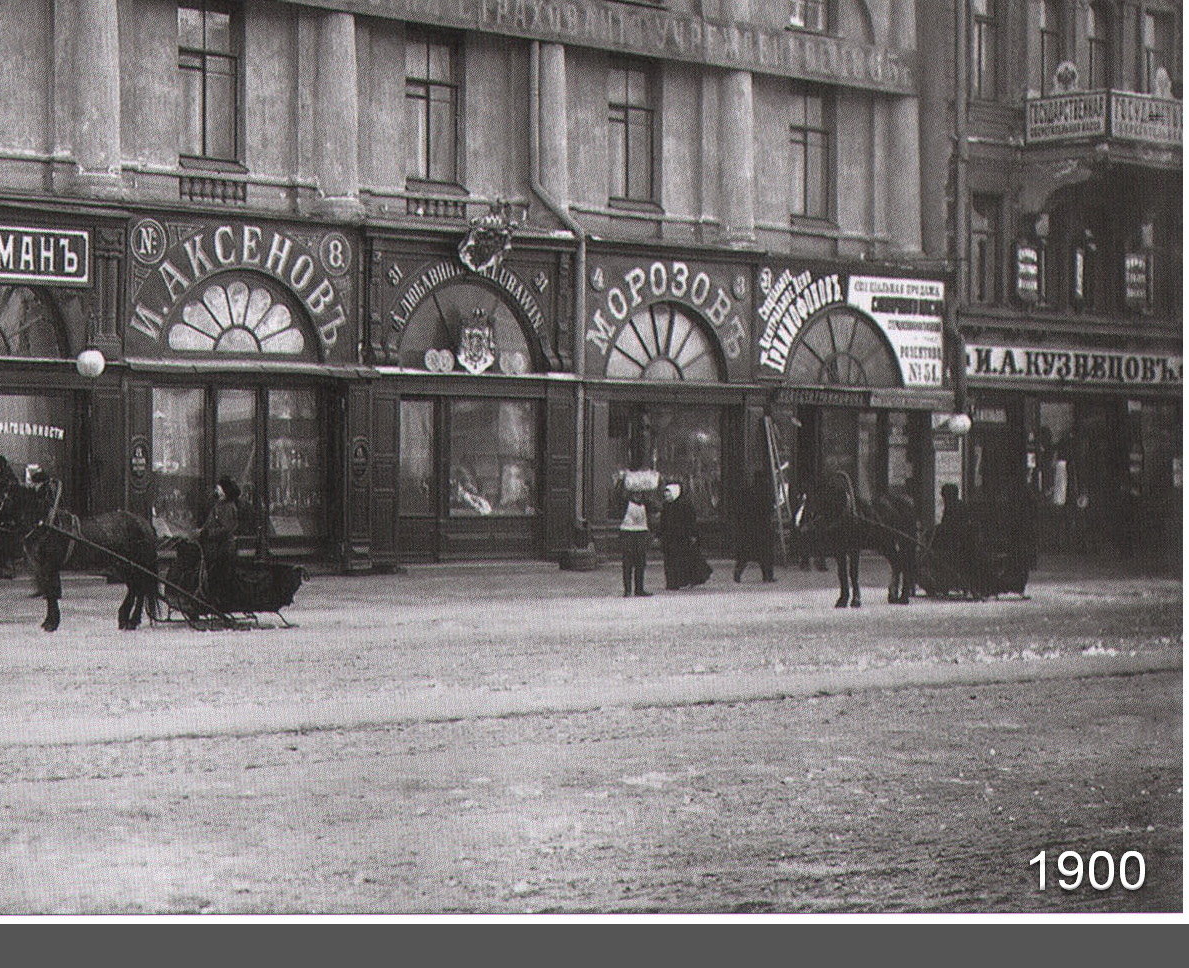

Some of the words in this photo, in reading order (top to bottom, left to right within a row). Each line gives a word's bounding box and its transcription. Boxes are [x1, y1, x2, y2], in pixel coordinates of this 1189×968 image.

[387, 263, 405, 286] 31
[534, 271, 549, 293] 31
[586, 261, 745, 359] МОРОЗОВЪ
